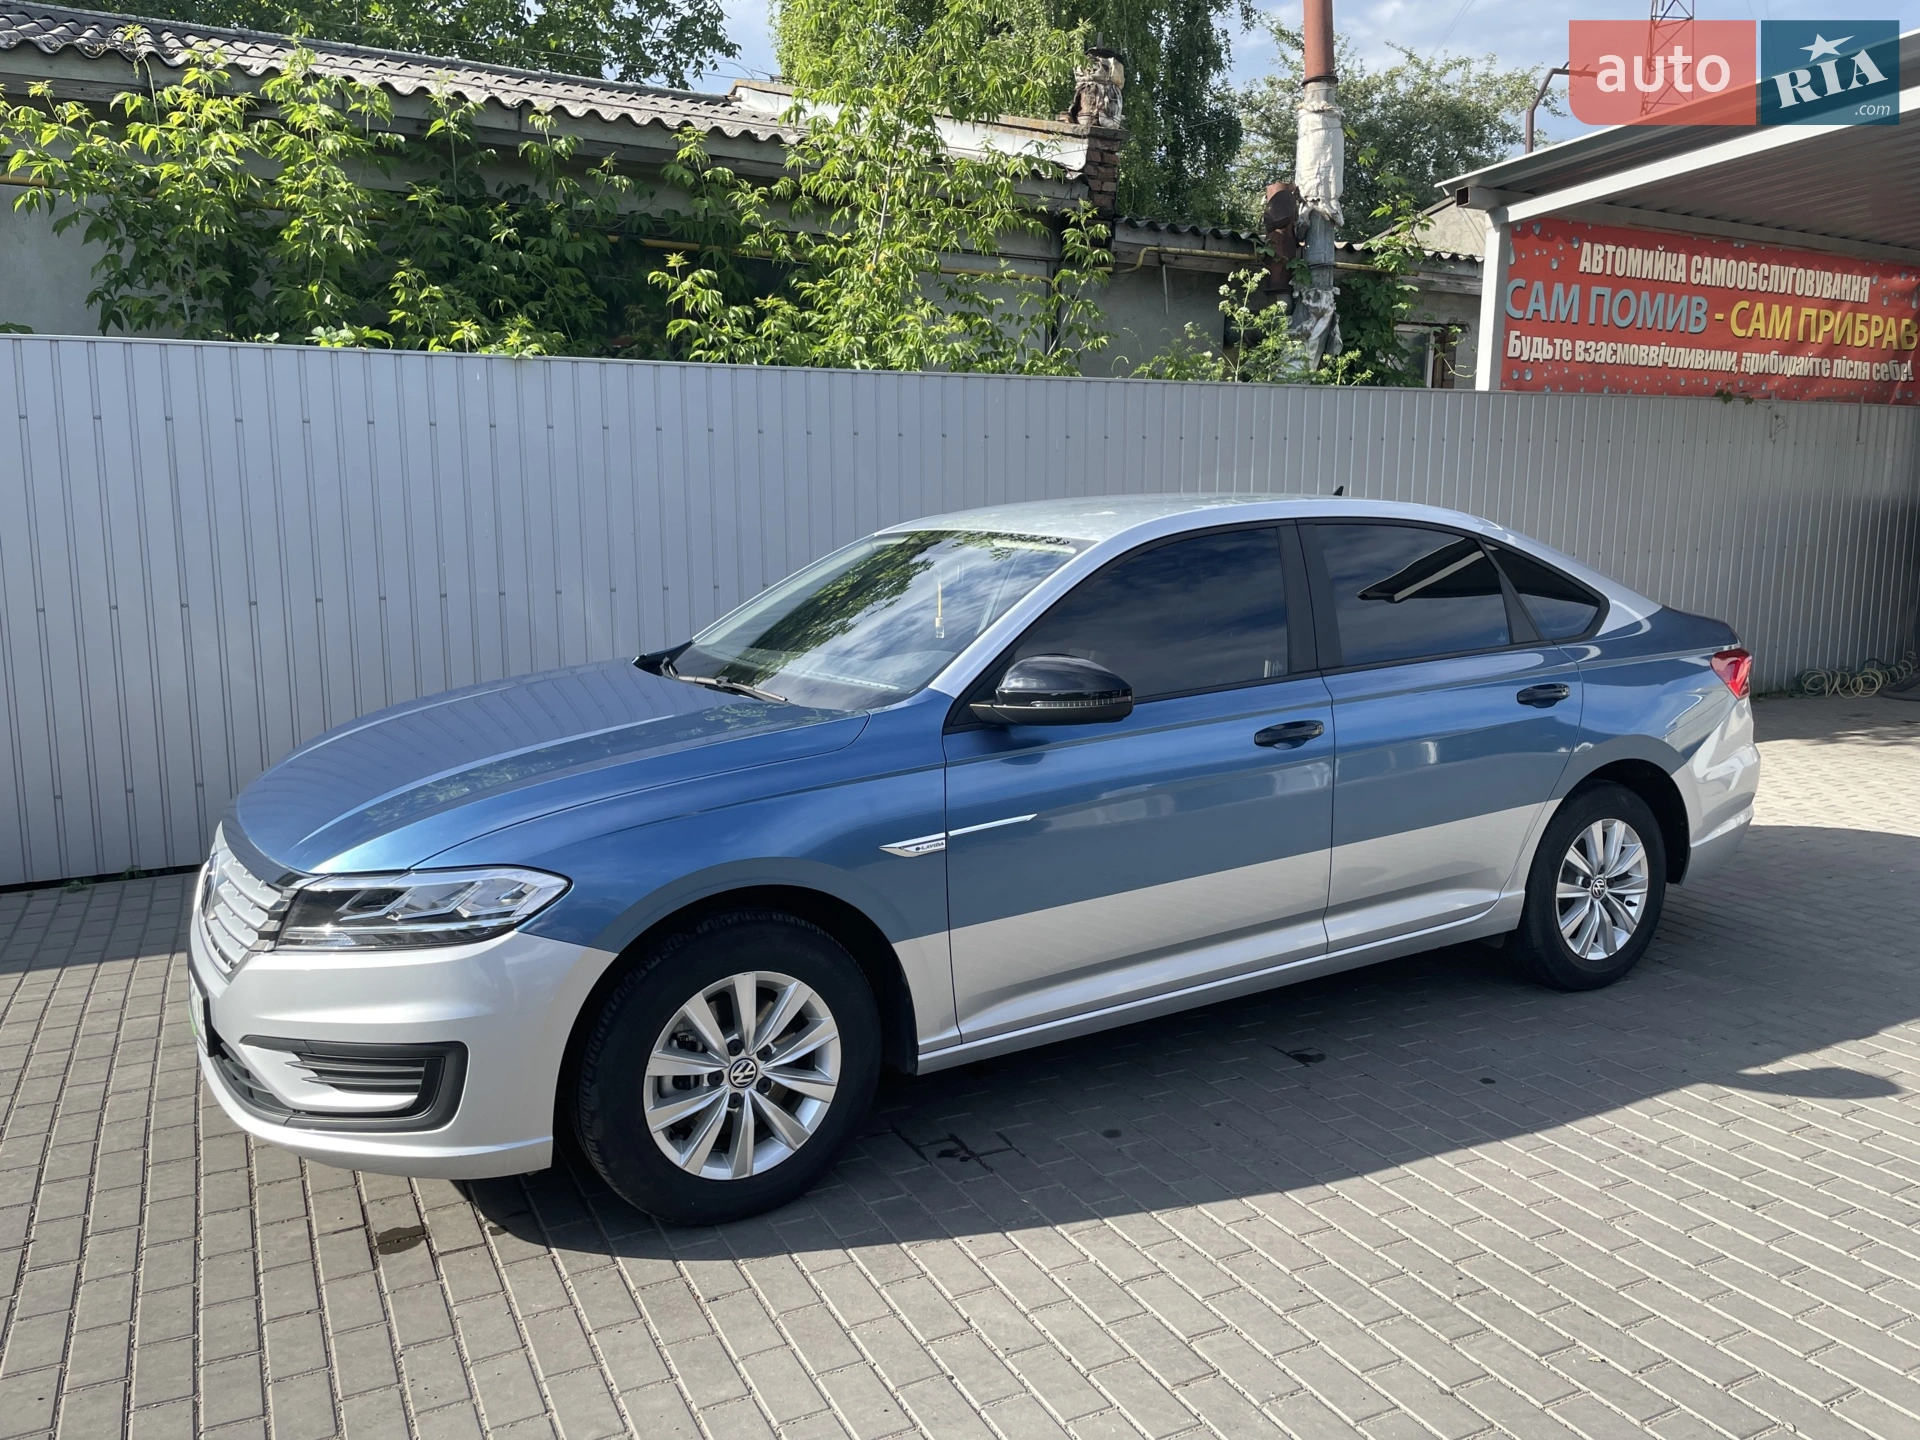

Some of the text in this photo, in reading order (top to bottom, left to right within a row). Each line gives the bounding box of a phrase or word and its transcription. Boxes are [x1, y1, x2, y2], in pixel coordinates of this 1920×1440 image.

[1579, 241, 1870, 303] АВТОМИЙКА САМООБСЛУГОВУВАННЯ
[1505, 279, 1580, 323] САМ
[1588, 286, 1708, 334] ПОМИВ
[1730, 300, 1792, 341] САМ
[1798, 308, 1918, 351] ПРИБРАВ
[1507, 330, 1572, 362] Будьте
[1741, 350, 1830, 378] прибирайте
[1832, 355, 1870, 381] після
[1872, 359, 1915, 382] себе!
